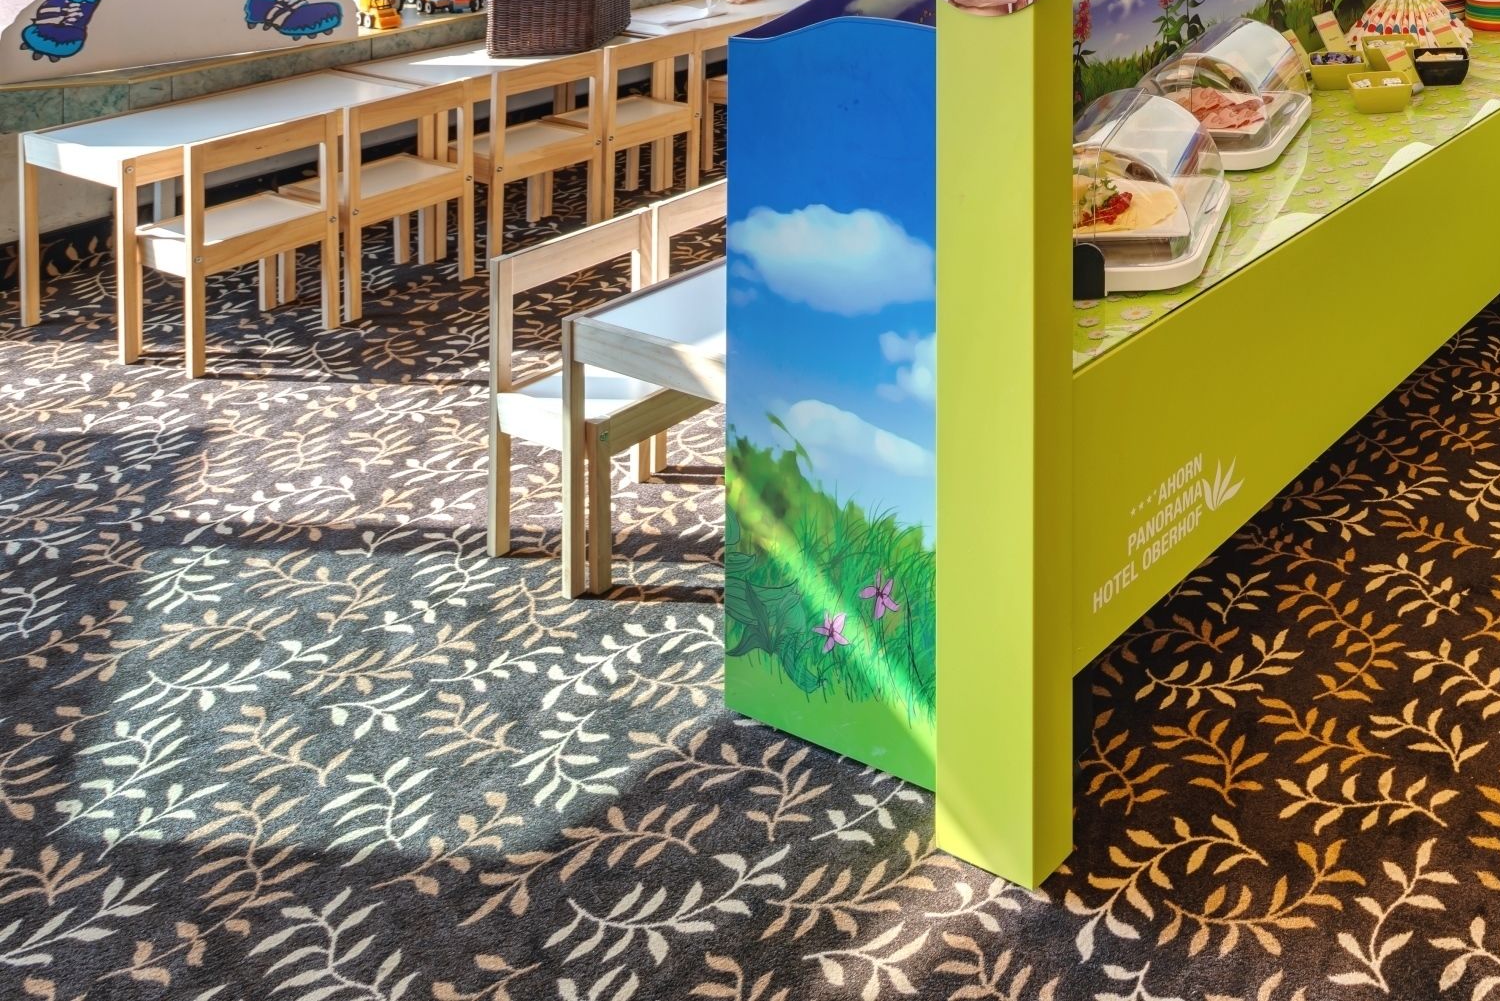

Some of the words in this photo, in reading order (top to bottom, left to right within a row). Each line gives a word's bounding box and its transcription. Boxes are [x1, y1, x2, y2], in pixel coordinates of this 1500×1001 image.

[1157, 452, 1203, 506] AHORN
[1128, 480, 1203, 556] PANORAMA
[1093, 560, 1139, 614] HOTEL
[1142, 504, 1203, 571] OBERHOF
